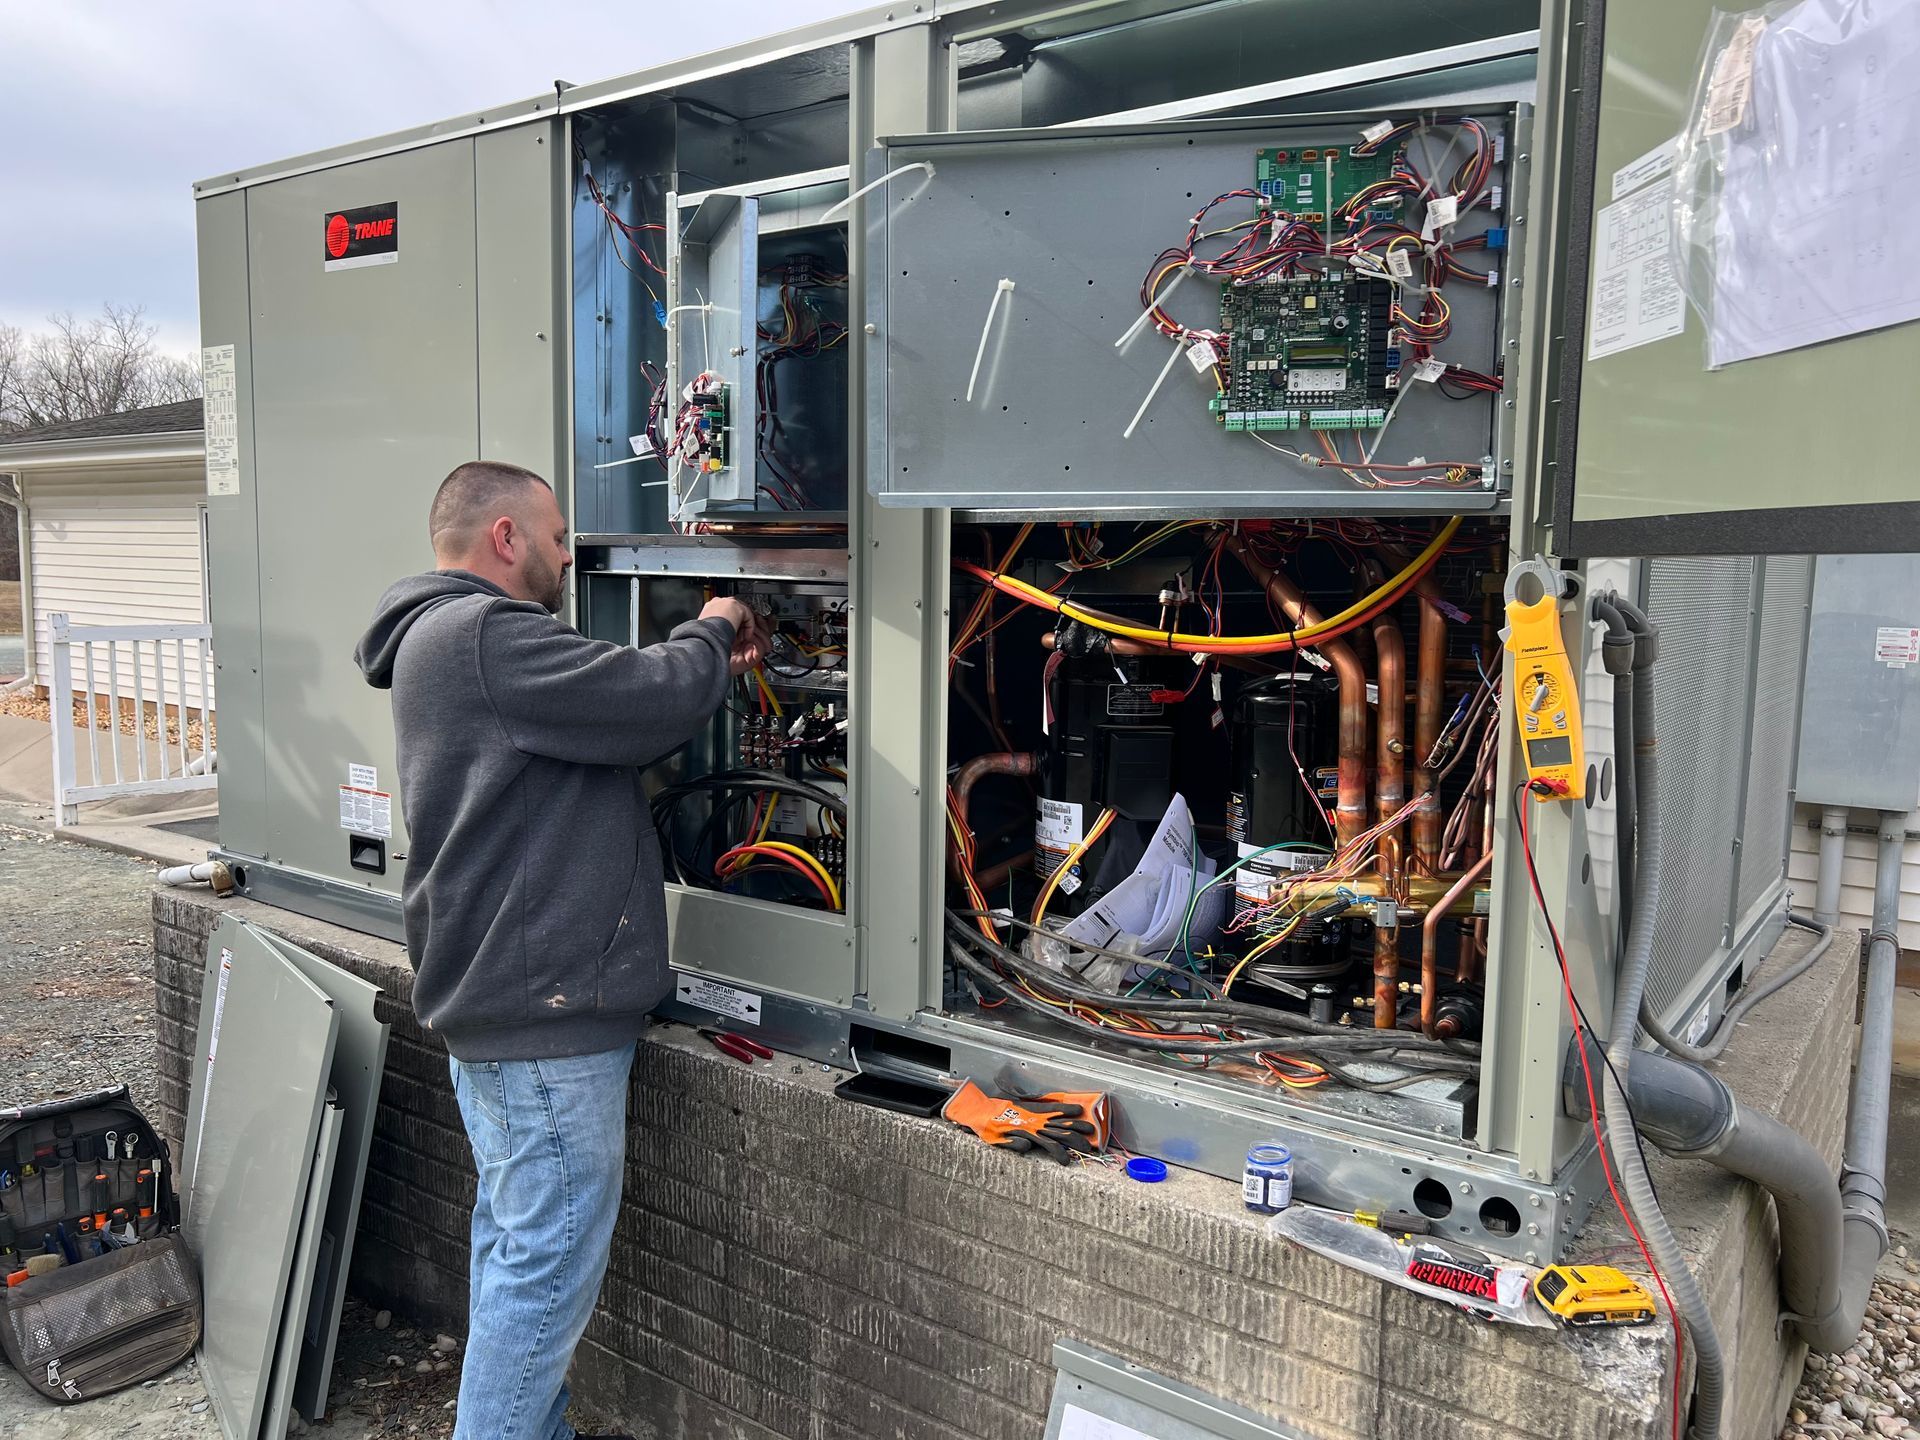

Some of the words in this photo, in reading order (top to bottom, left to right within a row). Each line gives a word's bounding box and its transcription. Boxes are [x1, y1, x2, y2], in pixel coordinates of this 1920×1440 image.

[355, 219, 394, 240] TRANE
[702, 981, 736, 996] IMPORTANT
[1412, 1261, 1490, 1296] STANDARD
